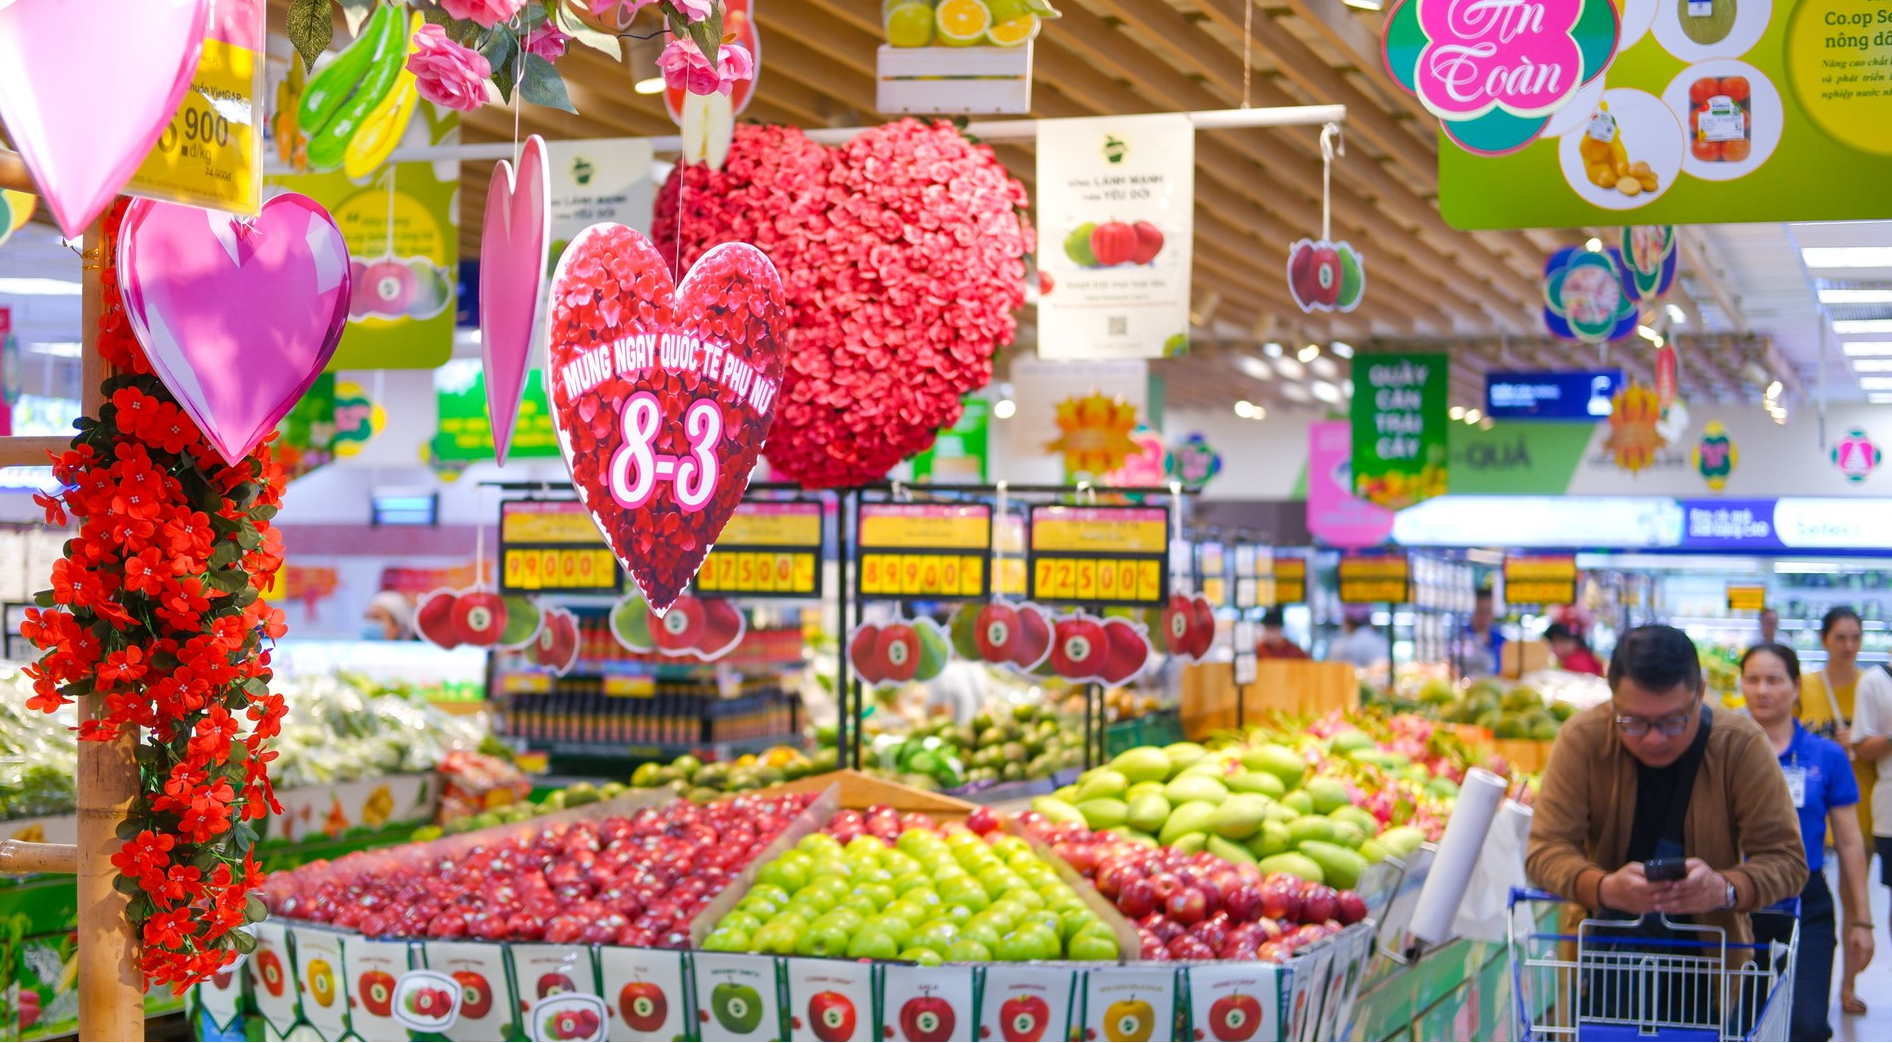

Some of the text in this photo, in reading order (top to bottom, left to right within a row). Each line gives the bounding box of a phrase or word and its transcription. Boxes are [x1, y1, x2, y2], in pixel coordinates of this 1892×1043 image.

[1825, 11, 1873, 28] Co.op
[1825, 32, 1869, 51] nông
[1430, 42, 1561, 102] Toàn
[1821, 74, 1832, 83] và
[1836, 73, 1858, 85] phát
[562, 323, 777, 416] MỪNG NGÀY QUỐC TẾ PHỤ NỮ
[609, 393, 722, 509] 8-3
